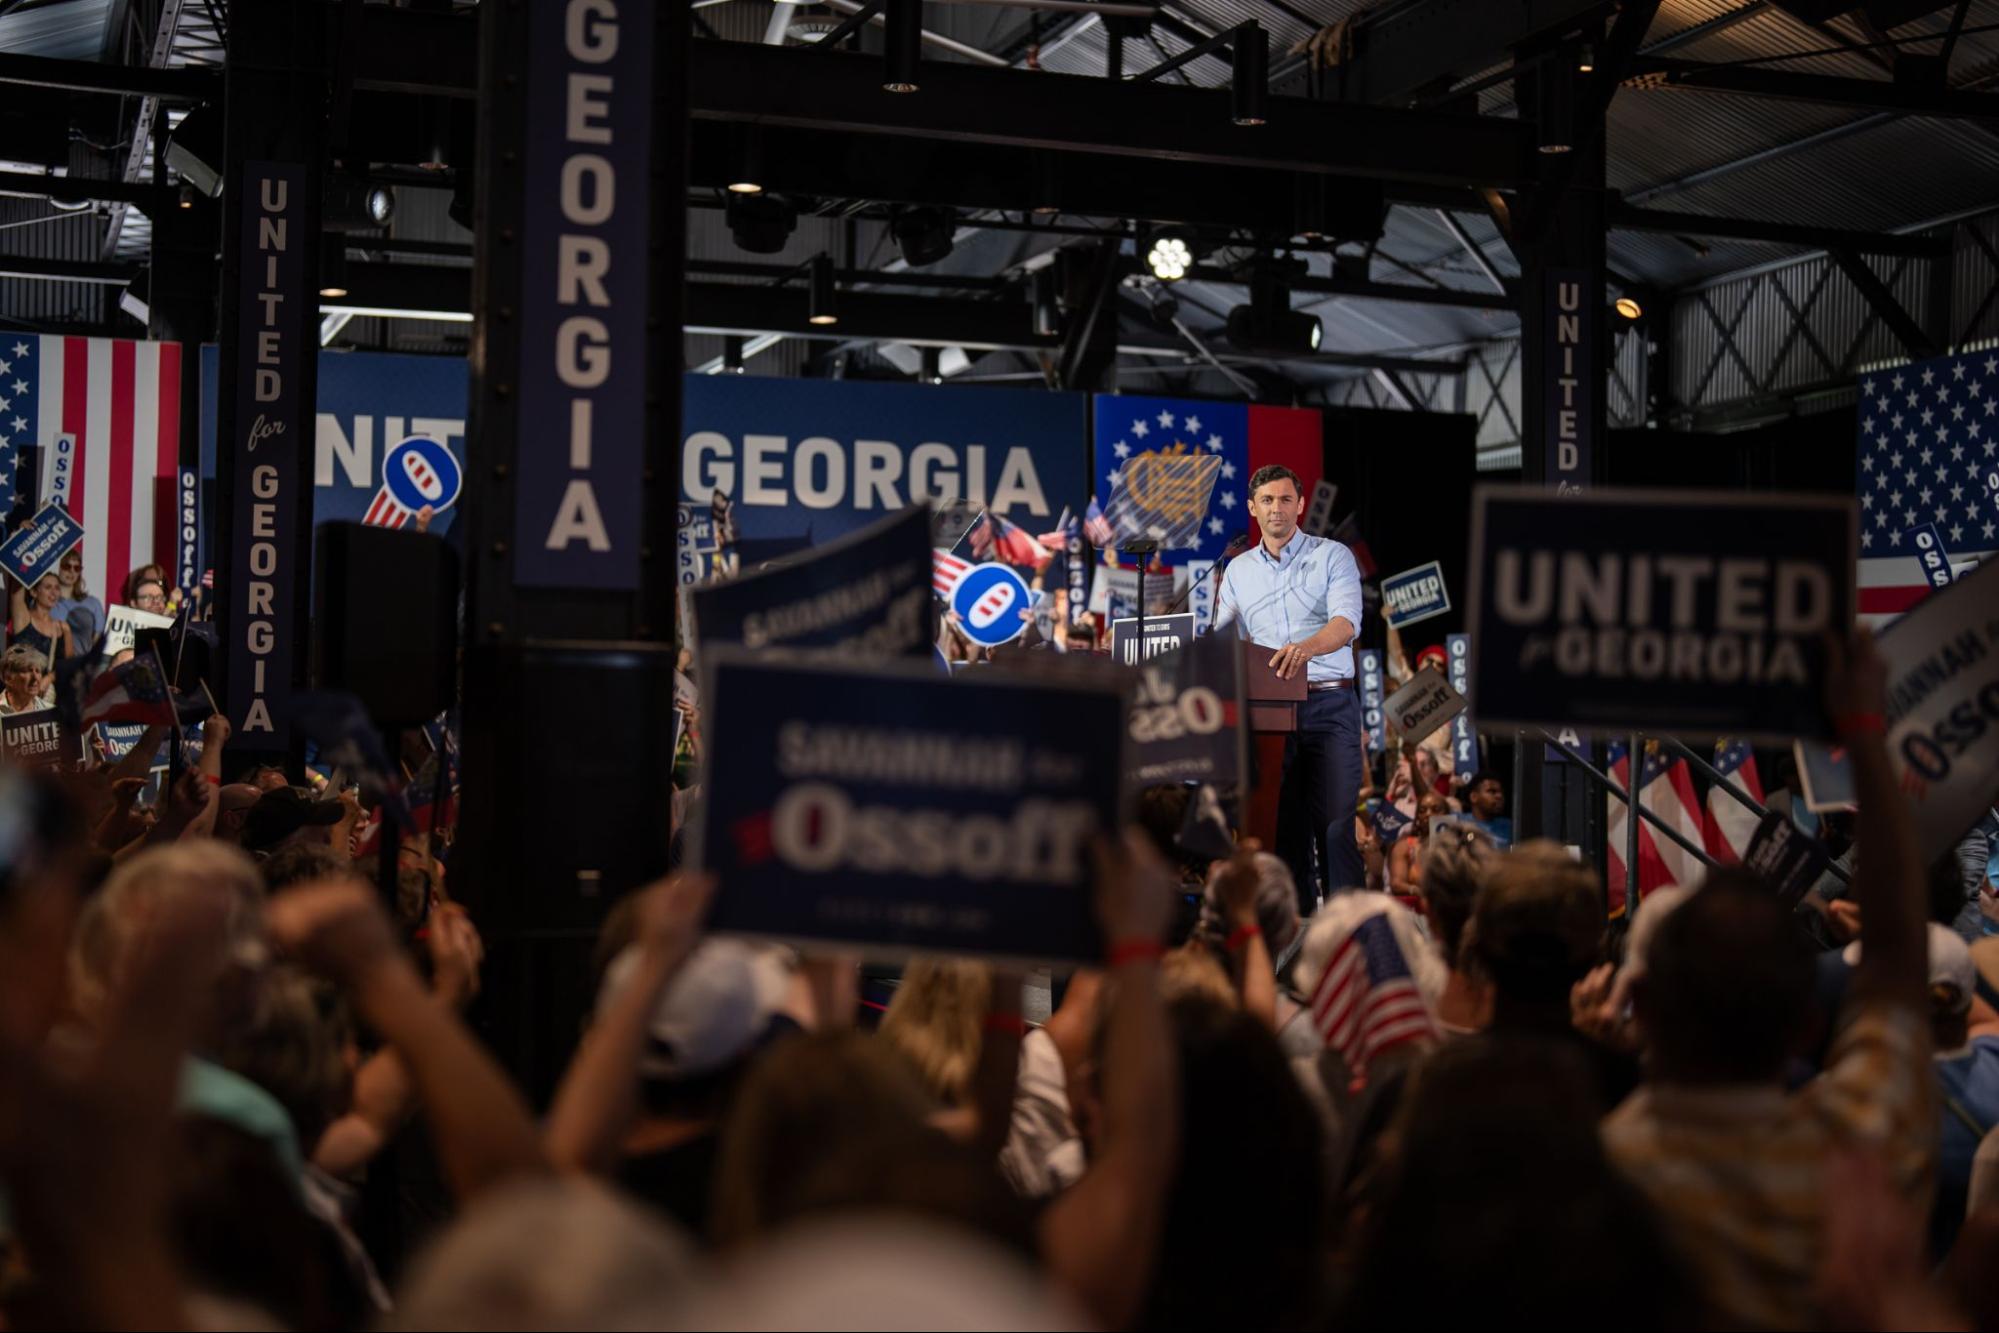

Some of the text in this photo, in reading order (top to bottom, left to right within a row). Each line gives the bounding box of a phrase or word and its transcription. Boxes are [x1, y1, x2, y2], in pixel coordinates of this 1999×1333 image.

[546, 0, 620, 551] GEORGIA
[1557, 282, 1580, 471] UNITED
[242, 178, 288, 733] UNITED for GEORGIA
[682, 430, 1052, 516] GEORGIA
[1386, 575, 1440, 607] UNITED
[1492, 546, 1835, 635] UNITED
[1552, 627, 1811, 686] GEORGIA
[1402, 686, 1451, 729] Ossoff
[768, 778, 1102, 887] Ossoff
